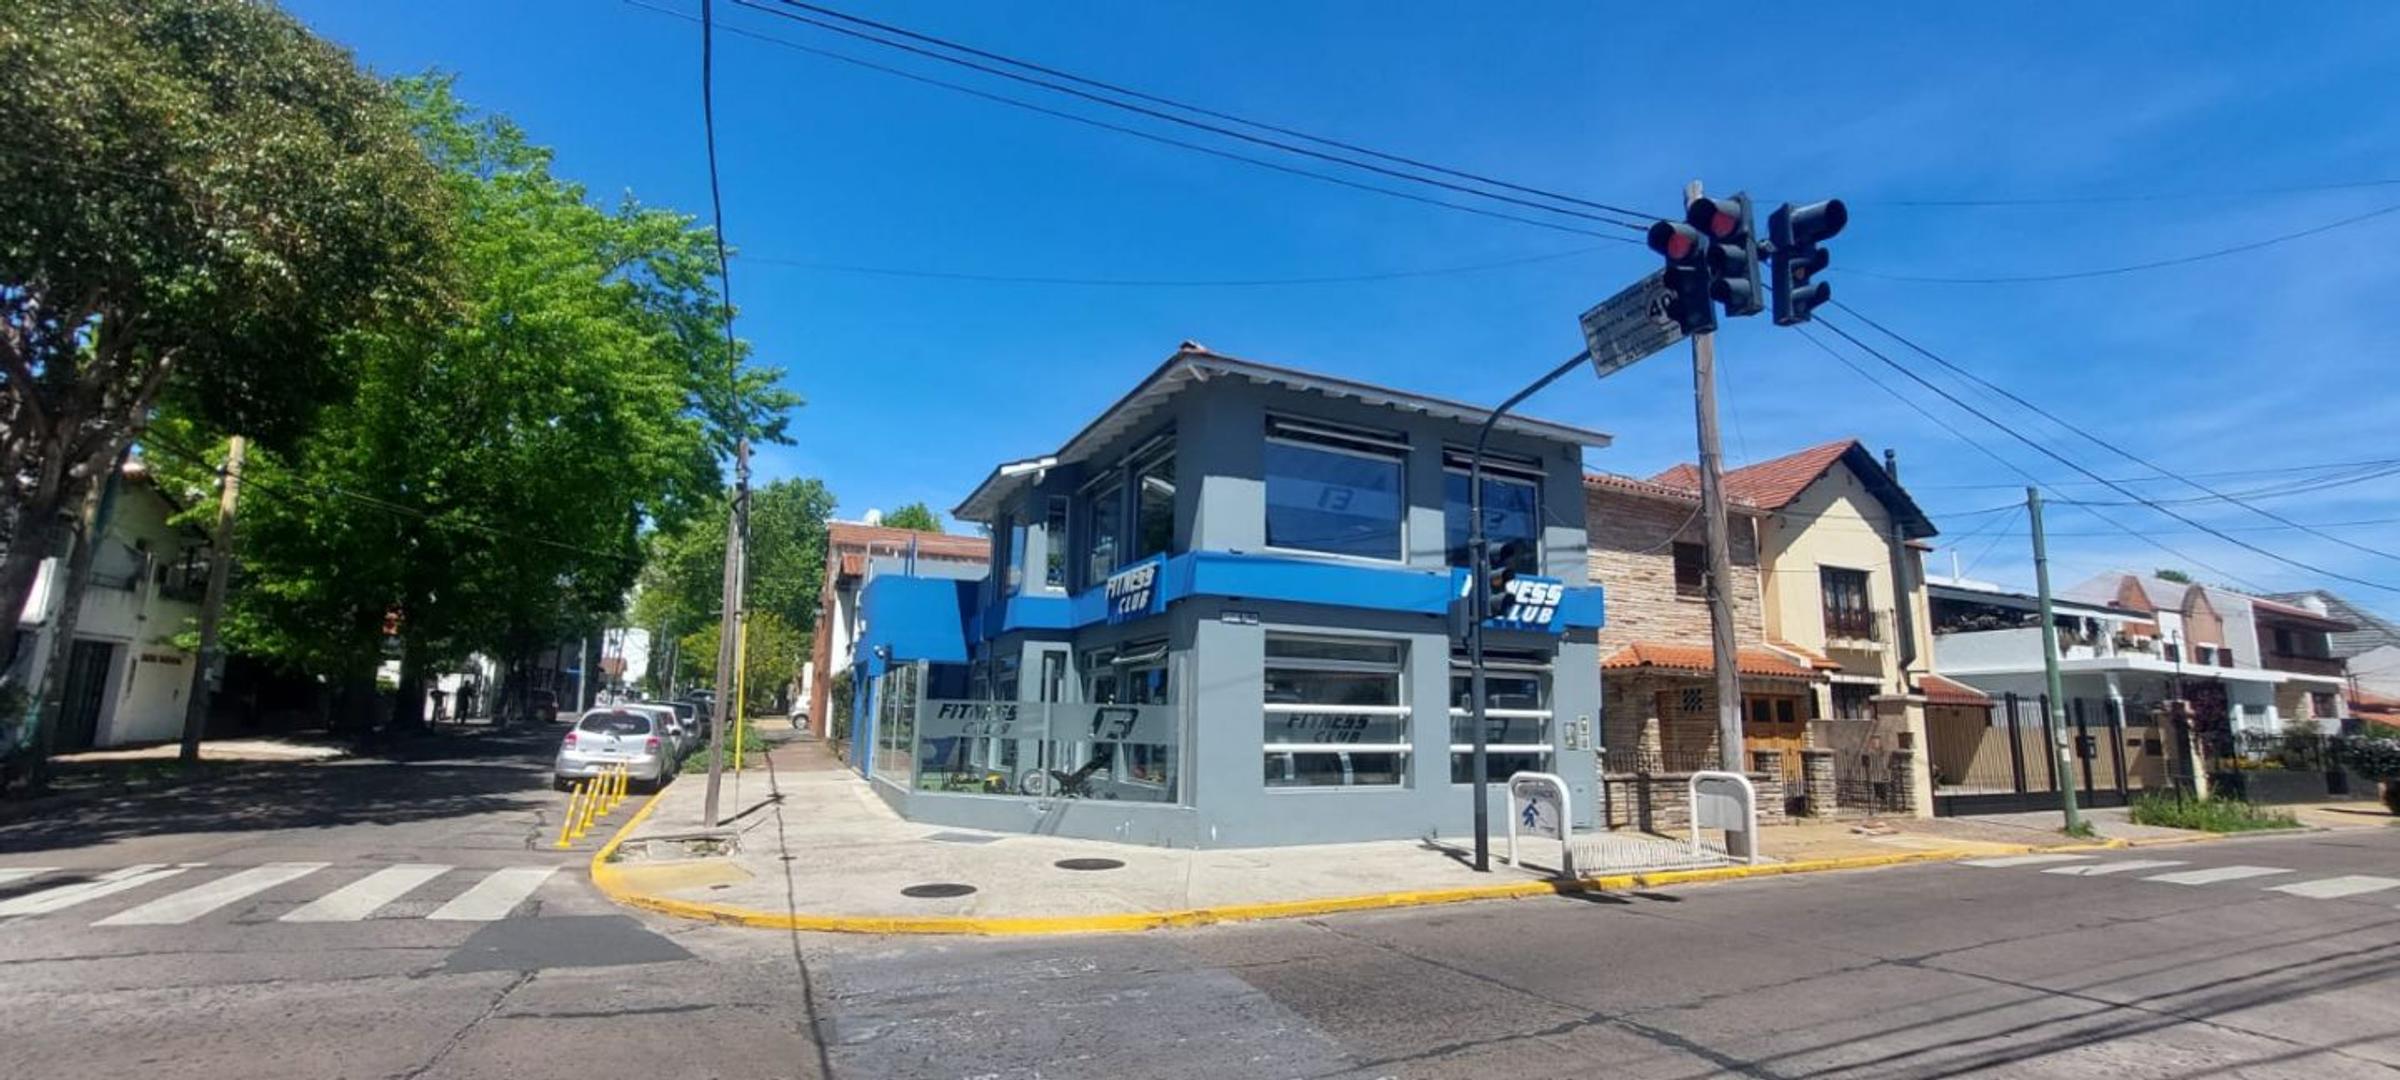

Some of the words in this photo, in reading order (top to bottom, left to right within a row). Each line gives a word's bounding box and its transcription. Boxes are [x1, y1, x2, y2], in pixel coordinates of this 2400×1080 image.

[1650, 294, 1673, 317] 40
[1105, 565, 1155, 600] FITNESS
[1461, 574, 1563, 606] NESS
[1119, 590, 1150, 614] CLUB
[1495, 604, 1554, 624] LUB
[961, 721, 1011, 735] CLB
[1287, 712, 1371, 730] FITNESS
[1314, 731, 1361, 743] CLUB
